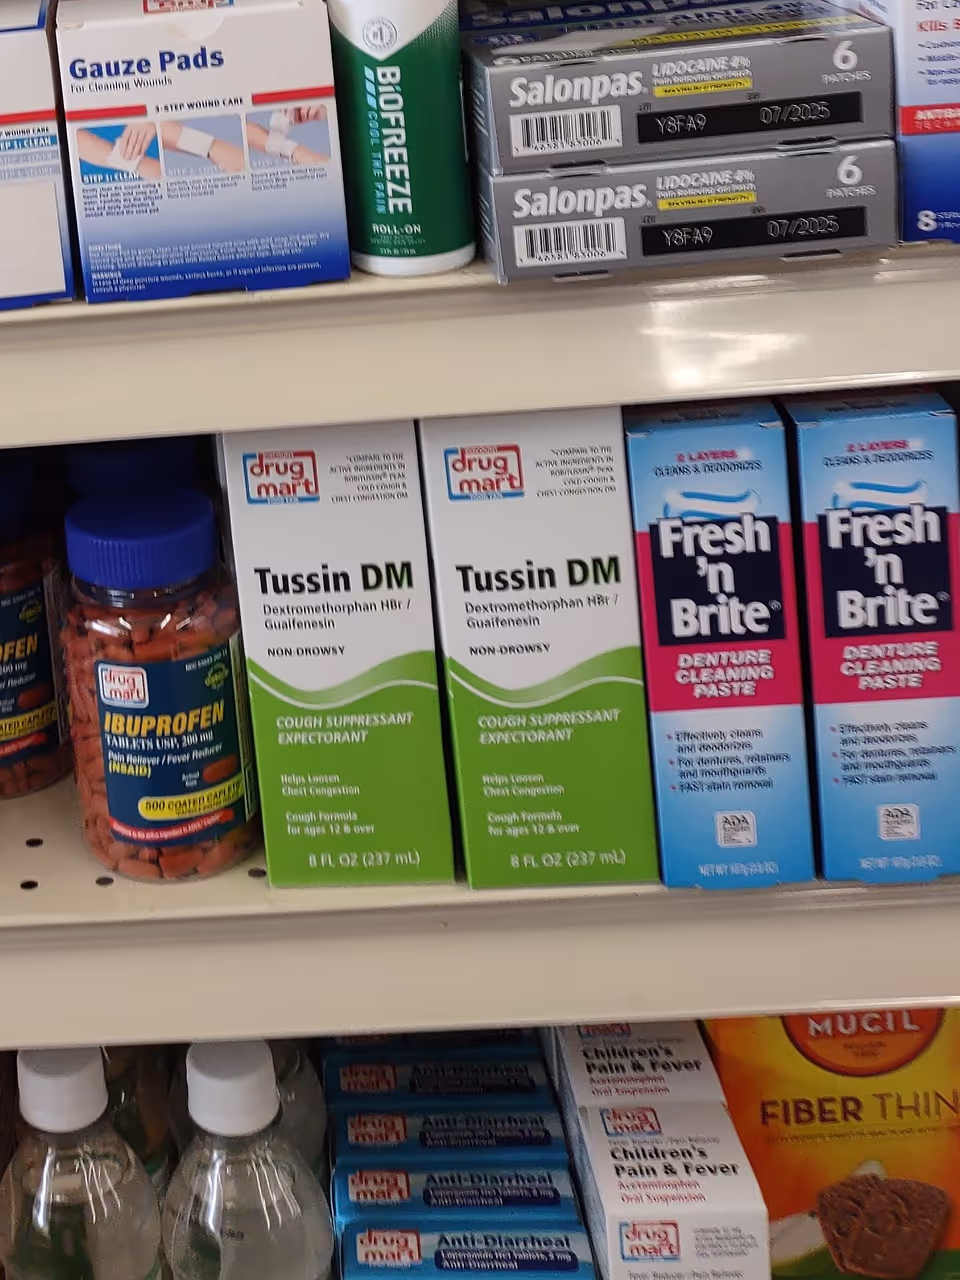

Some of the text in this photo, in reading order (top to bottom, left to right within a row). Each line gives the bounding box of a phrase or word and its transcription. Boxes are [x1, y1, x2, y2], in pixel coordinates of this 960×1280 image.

[69, 46, 224, 80] Gauze Pads
[833, 40, 858, 71] 6
[510, 71, 644, 108] Salonpas
[655, 102, 831, 134] Y8FA9 07/2025
[368, 112, 386, 214] COOL THE PAIN
[513, 183, 648, 219] Salonpas
[372, 223, 422, 235] ROLL-ON
[249, 453, 305, 481] drug
[256, 478, 319, 498] mart
[659, 512, 771, 559] Fresh
[254, 561, 414, 595] Tussin DM
[456, 555, 622, 593] Tussin DM
[670, 593, 771, 638] Brite
[678, 649, 772, 668] DENTURE
[104, 671, 145, 704] drug mart
[676, 666, 775, 684] CLEANING
[694, 682, 757, 699] PASTE
[105, 700, 224, 737] IBUPROFEN
[276, 712, 415, 730] COUGH SUPPRESSANT
[277, 731, 368, 745] EXPECTORANT
[807, 1010, 921, 1038] MUCIL
[760, 1095, 864, 1126] FIBER
[611, 1144, 708, 1161] Children's
[614, 1160, 740, 1179] Pain & Fever
[439, 1232, 571, 1249] Anti-Diarrheal
